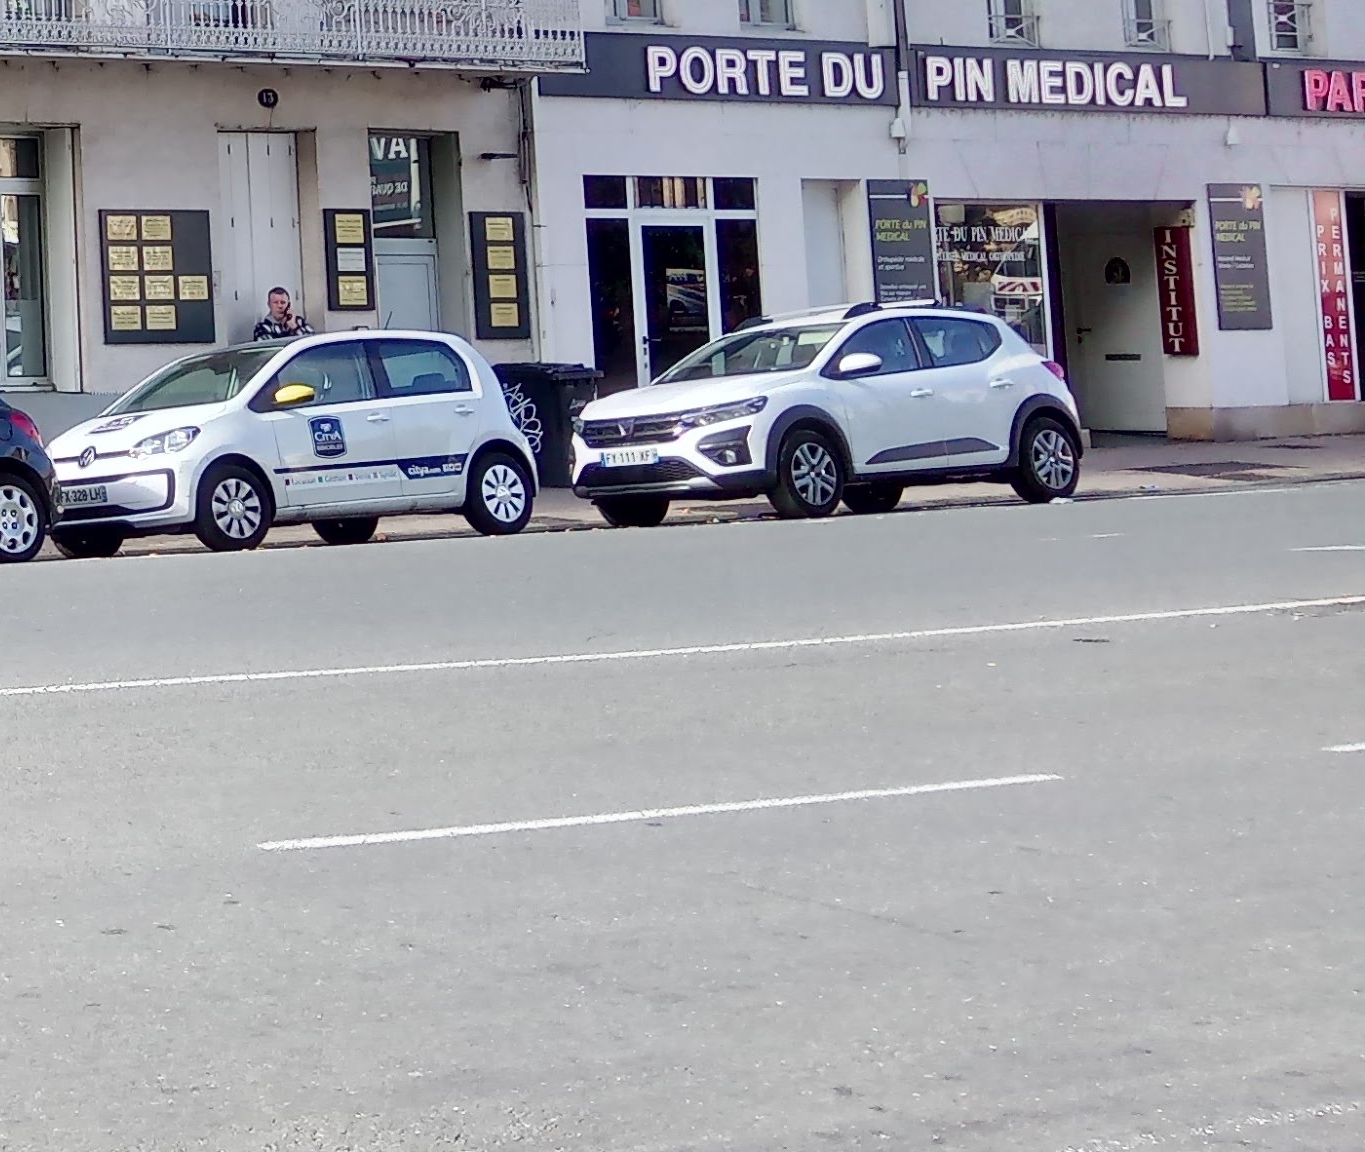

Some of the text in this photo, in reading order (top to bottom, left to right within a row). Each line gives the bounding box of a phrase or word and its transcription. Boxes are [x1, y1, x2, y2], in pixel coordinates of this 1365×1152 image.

[263, 92, 274, 103] 13
[647, 45, 1188, 107] PORTE DU PIN MEDICAL
[875, 219, 900, 229] PORTE
[971, 227, 987, 242] PIN
[988, 226, 1027, 242] MEDICA
[1160, 229, 1185, 352] INSTITUT
[1316, 224, 1336, 366] PRIX BAS
[1329, 207, 1351, 384] PERMANENTS
